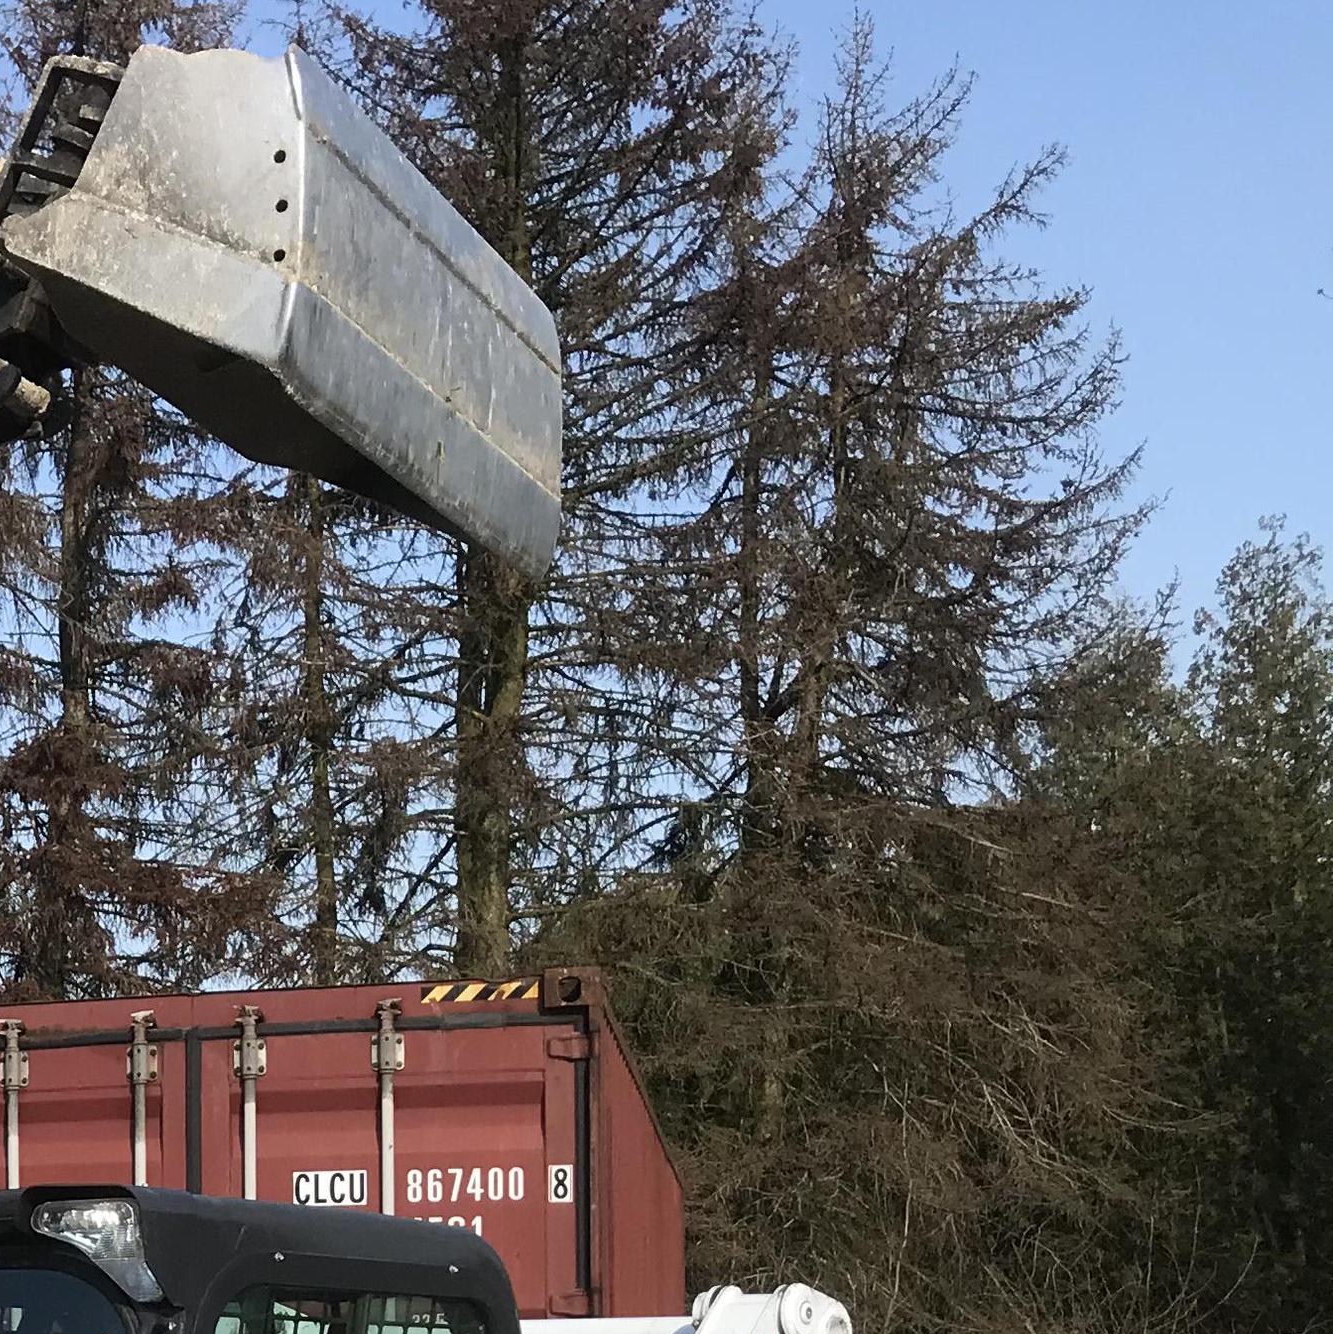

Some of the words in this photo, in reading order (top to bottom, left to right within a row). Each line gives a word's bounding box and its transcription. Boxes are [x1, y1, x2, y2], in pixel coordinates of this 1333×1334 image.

[295, 1173, 365, 1205] CLCU
[407, 1166, 524, 1203] 867400
[553, 1168, 569, 1199] 8
